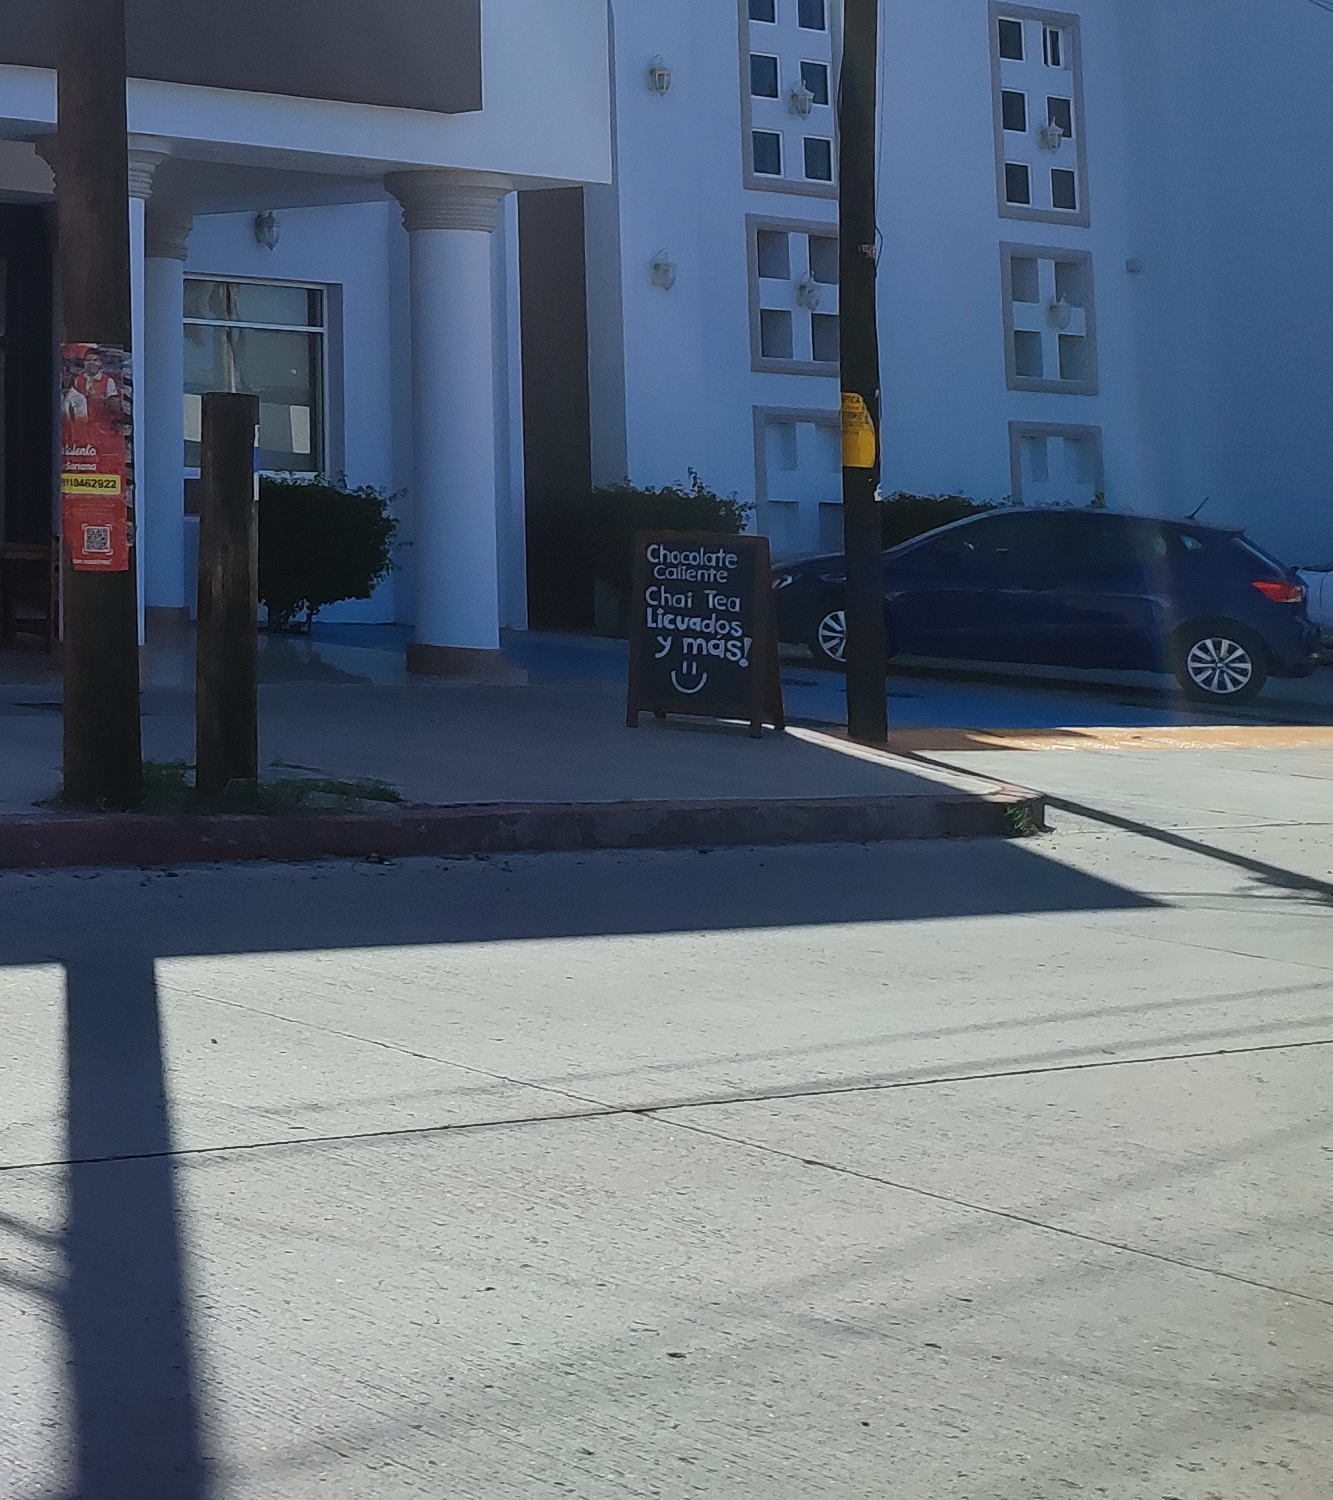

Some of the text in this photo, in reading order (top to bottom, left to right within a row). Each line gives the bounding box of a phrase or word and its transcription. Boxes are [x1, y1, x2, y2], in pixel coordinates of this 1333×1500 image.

[646, 544, 738, 568] Chocolate
[653, 564, 728, 583] Caliente
[645, 585, 741, 612] Chai Tea
[646, 607, 743, 637] Licuados
[654, 634, 753, 667] y más!
